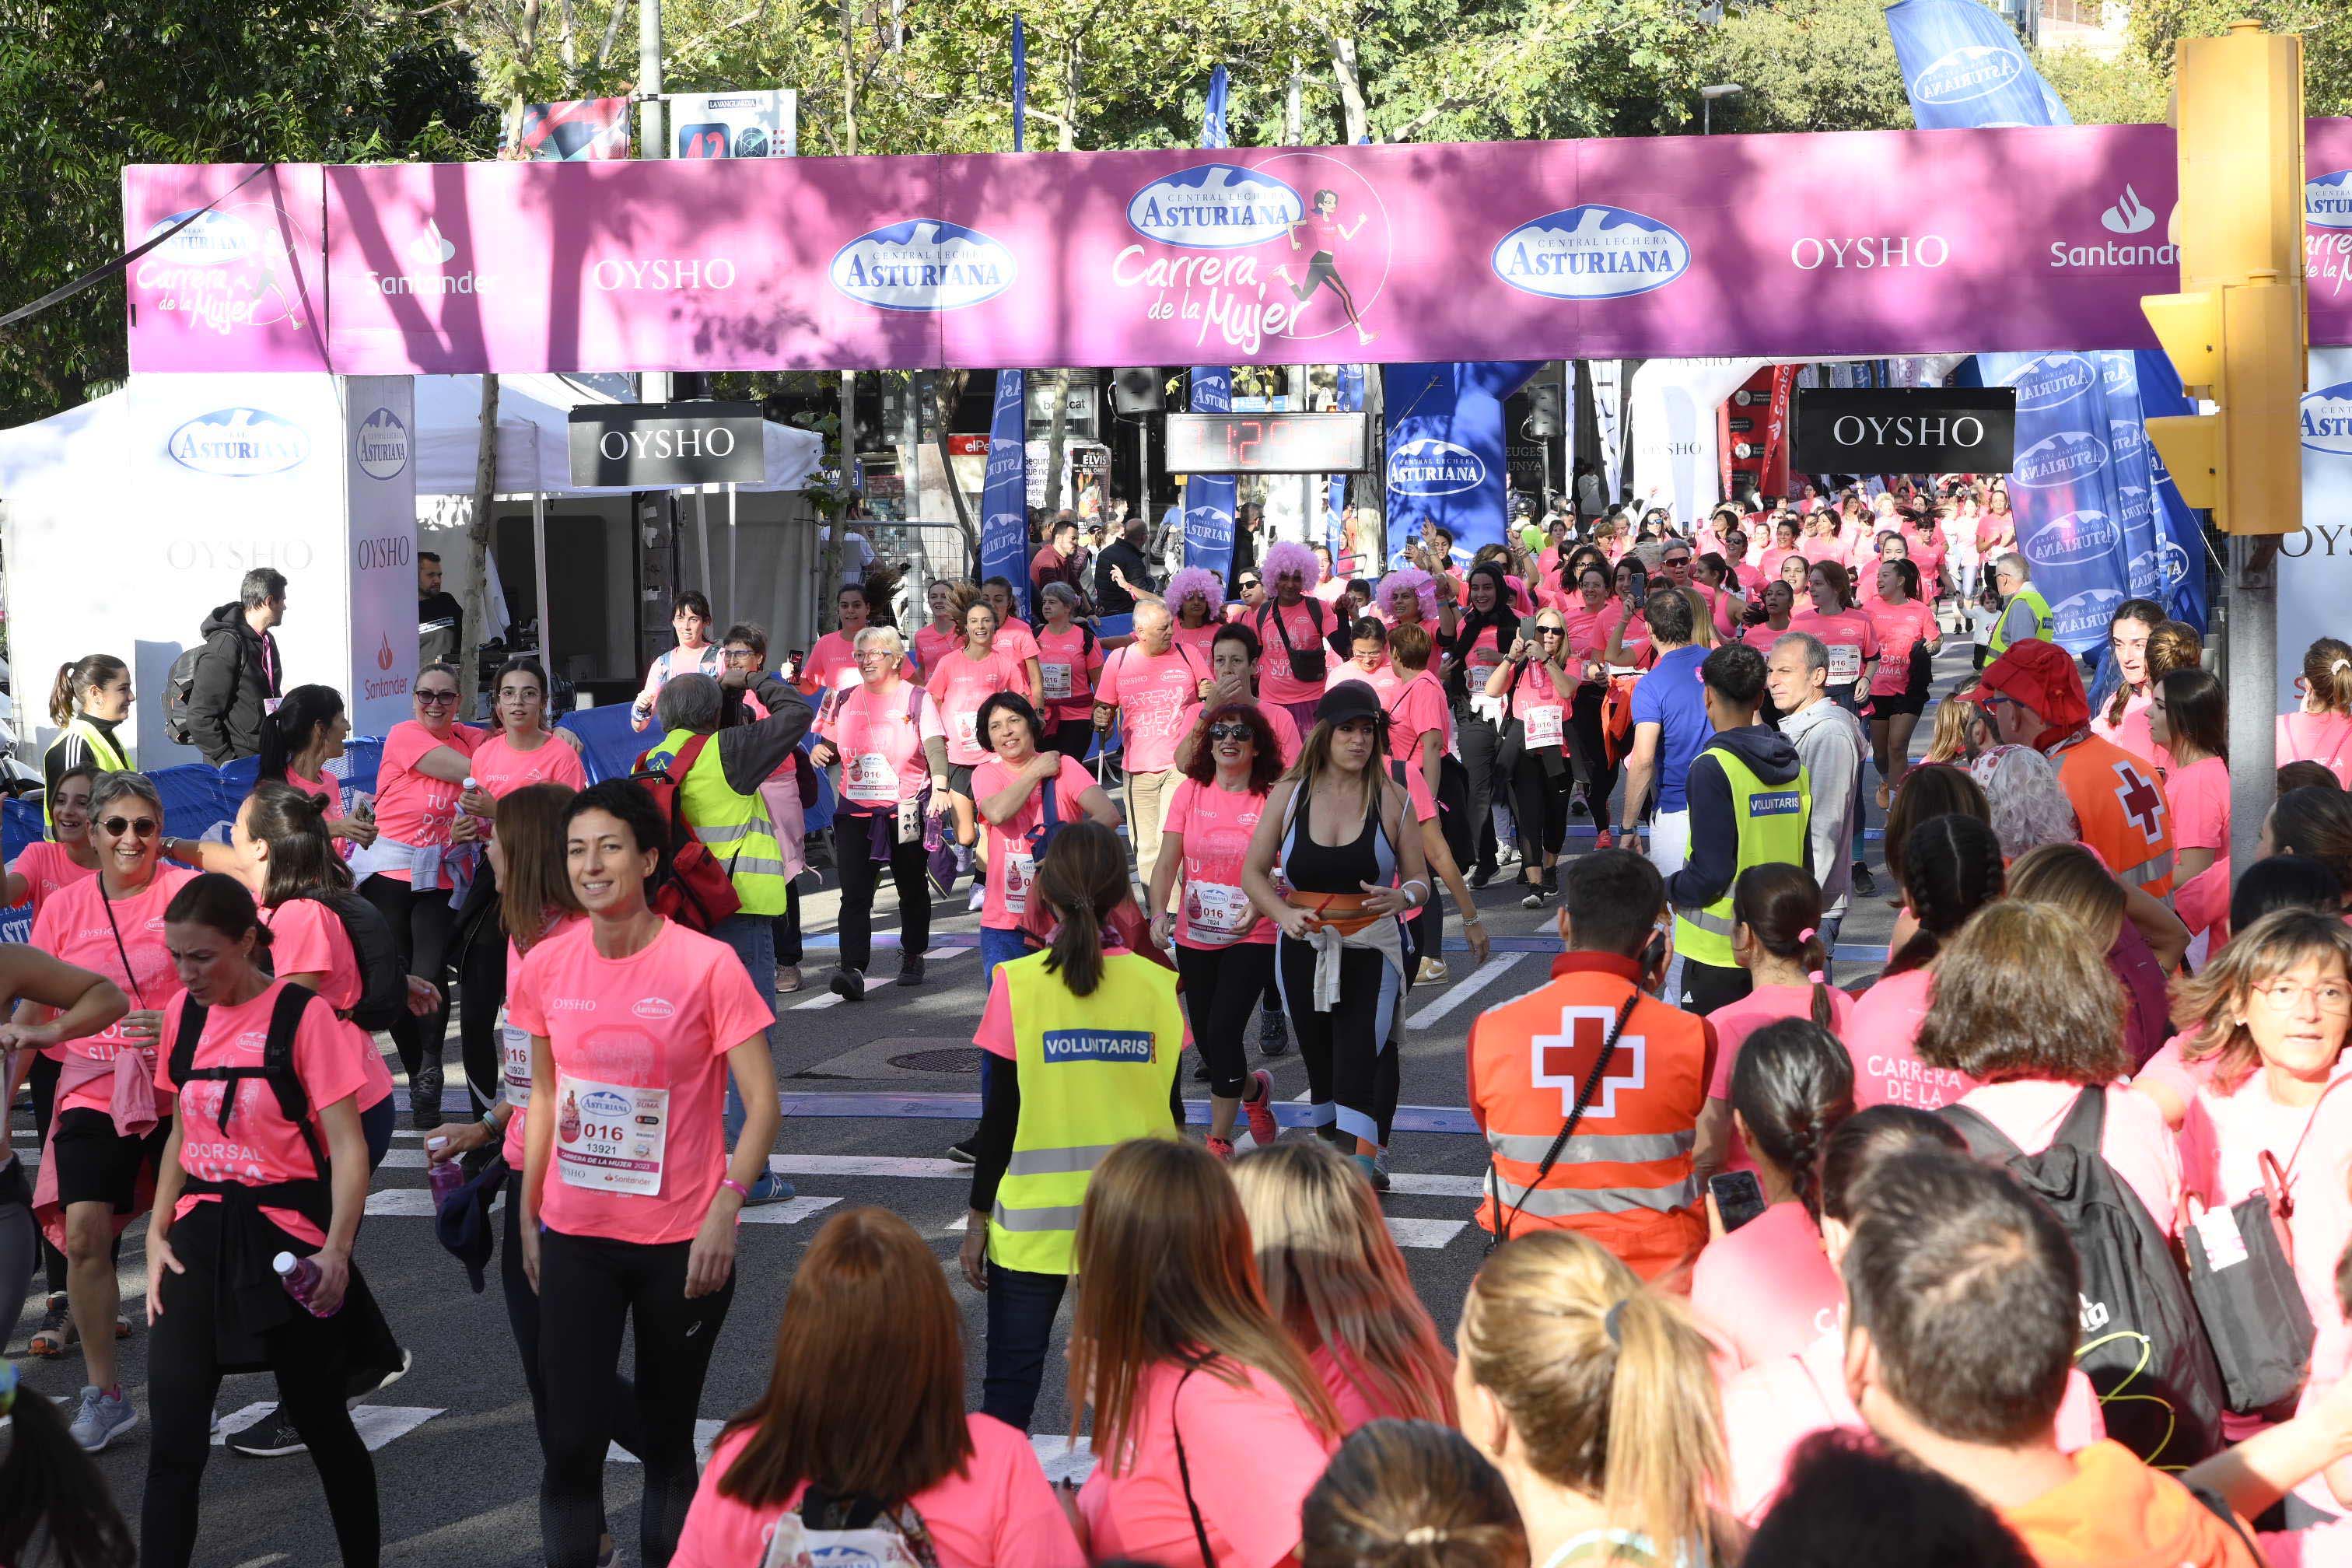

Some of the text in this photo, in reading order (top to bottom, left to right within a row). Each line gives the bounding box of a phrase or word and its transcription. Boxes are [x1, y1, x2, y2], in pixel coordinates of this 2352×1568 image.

[1167, 193, 1222, 202] CENTRAL
[1141, 196, 1290, 227] ASTURIANA
[1538, 236, 1668, 249] CENTRAL LECHERA
[1790, 236, 1949, 270] OYSHO
[2051, 240, 2182, 267] Santand
[873, 251, 931, 260] CENTRAL
[1113, 244, 1258, 288] Carrera
[1507, 241, 1675, 275] ASTURIANA
[2322, 254, 2336, 278] la
[136, 262, 229, 289] Carrera
[593, 258, 736, 292] OYSHO
[845, 254, 1002, 287] ASTURIANA
[364, 271, 499, 295] Santander
[159, 277, 263, 334] de la Mujer
[1148, 283, 1312, 355] de la Mujer
[1833, 415, 1984, 447] OYSHO
[180, 433, 301, 459] ASTURIANA
[360, 435, 405, 462] ASTURIANA
[599, 427, 736, 461] OYSHO
[1083, 455, 1107, 465] ELVIS
[1390, 463, 1479, 483] ASTURIANA
[2278, 525, 2352, 557] OY
[358, 535, 410, 571] OYSHO
[365, 674, 408, 701] Santander
[1120, 675, 1148, 685] OYSHO
[1122, 688, 1177, 706] CARRERA
[842, 747, 857, 758] TU
[428, 794, 447, 810] TU
[1750, 796, 1799, 811] VOLUNTARIS
[1003, 838, 1022, 852] TU
[1186, 857, 1201, 873] TU
[1203, 908, 1223, 919] 016
[553, 998, 597, 1011] OYSHO
[1045, 1038, 1149, 1055] VOLUNTARIS
[1867, 1055, 1962, 1090] CARRERA
[1887, 1079, 1913, 1101] DE
[1919, 1084, 1944, 1107] LA
[583, 1098, 628, 1112] ASTURIANA
[584, 1123, 624, 1141] 016
[187, 1142, 264, 1162] DORSAL
[561, 1151, 586, 1164] CARRERA
[609, 1160, 632, 1168] MUJER
[586, 1142, 617, 1156] 13921
[614, 1174, 651, 1186] Santander
